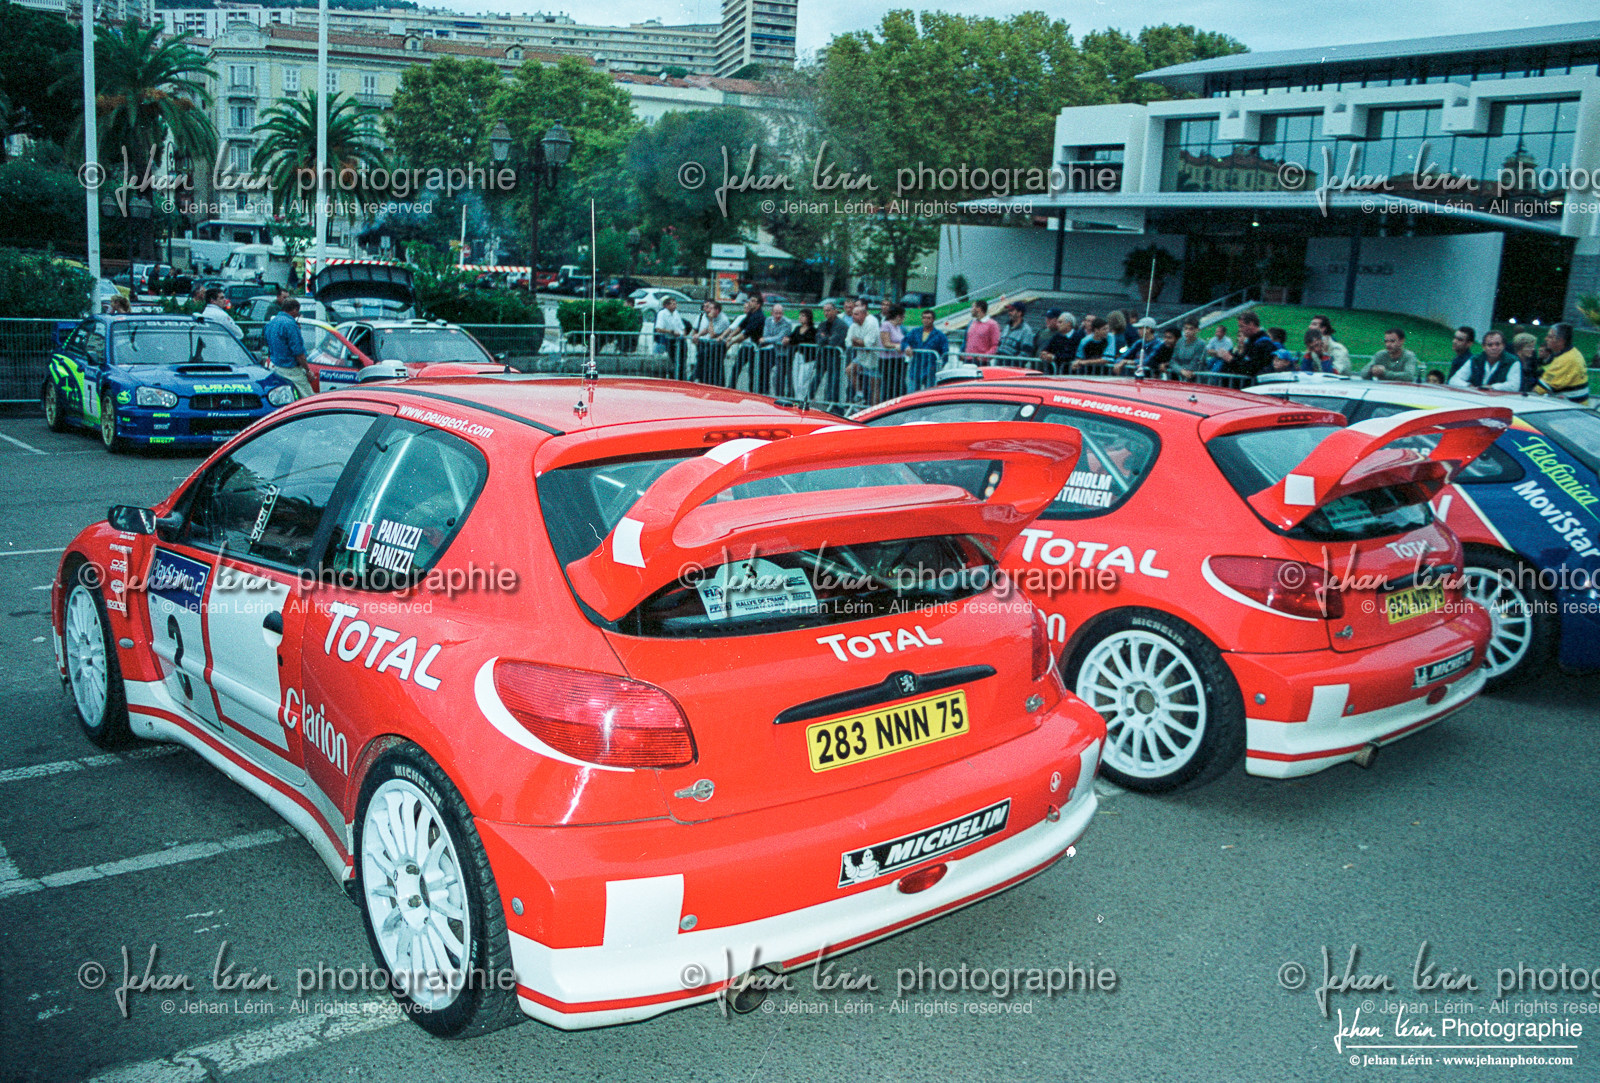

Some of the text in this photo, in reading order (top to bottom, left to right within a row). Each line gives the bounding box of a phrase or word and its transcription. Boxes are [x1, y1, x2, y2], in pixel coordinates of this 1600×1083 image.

[399, 404, 494, 438] www.peugeot.com
[1052, 395, 1161, 421] www.peugeot.com
[377, 519, 423, 550] PANIZZI
[1512, 479, 1600, 558] MoviStar
[369, 542, 415, 575] PANIZZI
[1019, 528, 1169, 579] TOTAL
[324, 600, 443, 692] TOTAL
[816, 625, 943, 662] TOTAL
[1131, 616, 1186, 647] MICHELIN
[283, 687, 349, 777] Clarion
[816, 697, 964, 765] 283 NNN 75
[394, 765, 442, 807] MICHELIN
[885, 805, 1008, 866] MICHELIN
